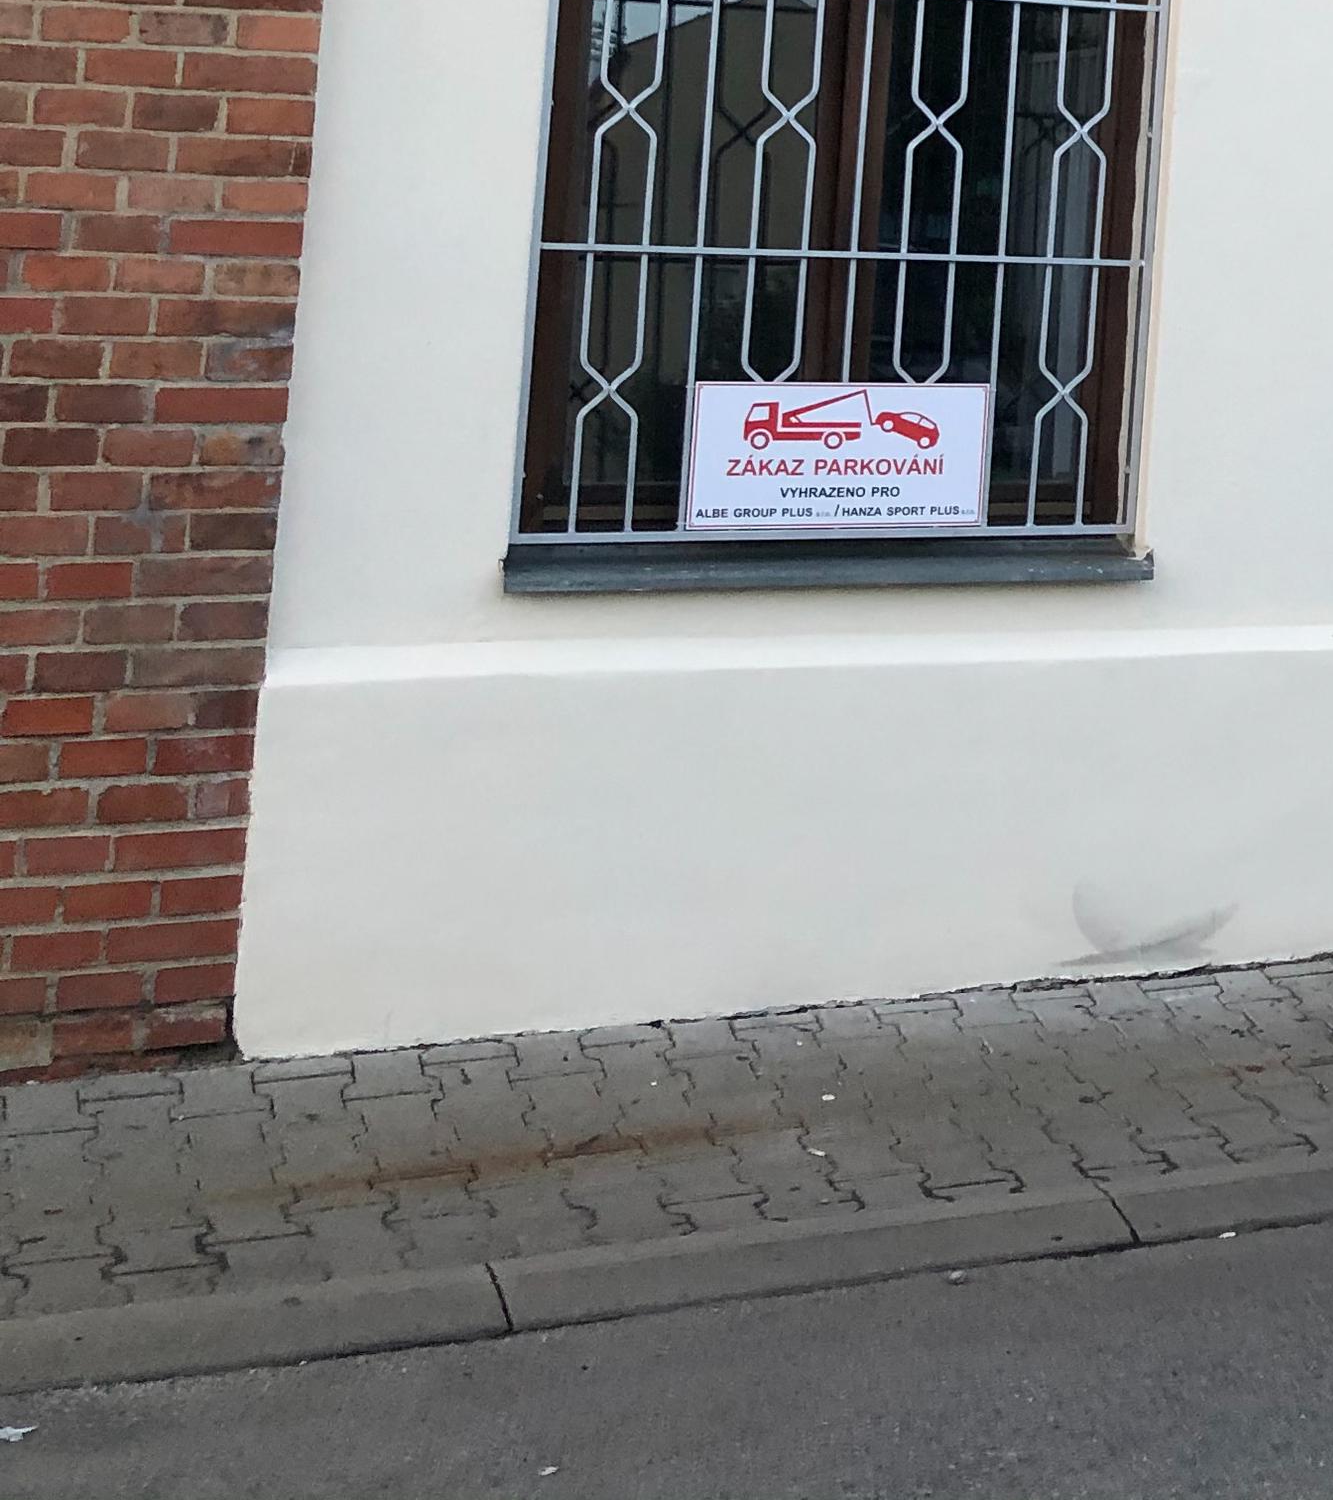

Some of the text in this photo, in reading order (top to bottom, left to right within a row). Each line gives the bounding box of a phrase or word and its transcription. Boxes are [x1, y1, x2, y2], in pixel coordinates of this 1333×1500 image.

[726, 454, 945, 476] ZÁKAZ PARKOVÁNÍ
[780, 486, 901, 499] VYHRAZENO PRO
[696, 508, 729, 519] ALBE
[733, 507, 777, 518] GROUP
[781, 507, 813, 517] PLUS
[842, 506, 882, 517] HANZA
[886, 506, 926, 516] SPORT
[930, 506, 960, 515] PLUS
